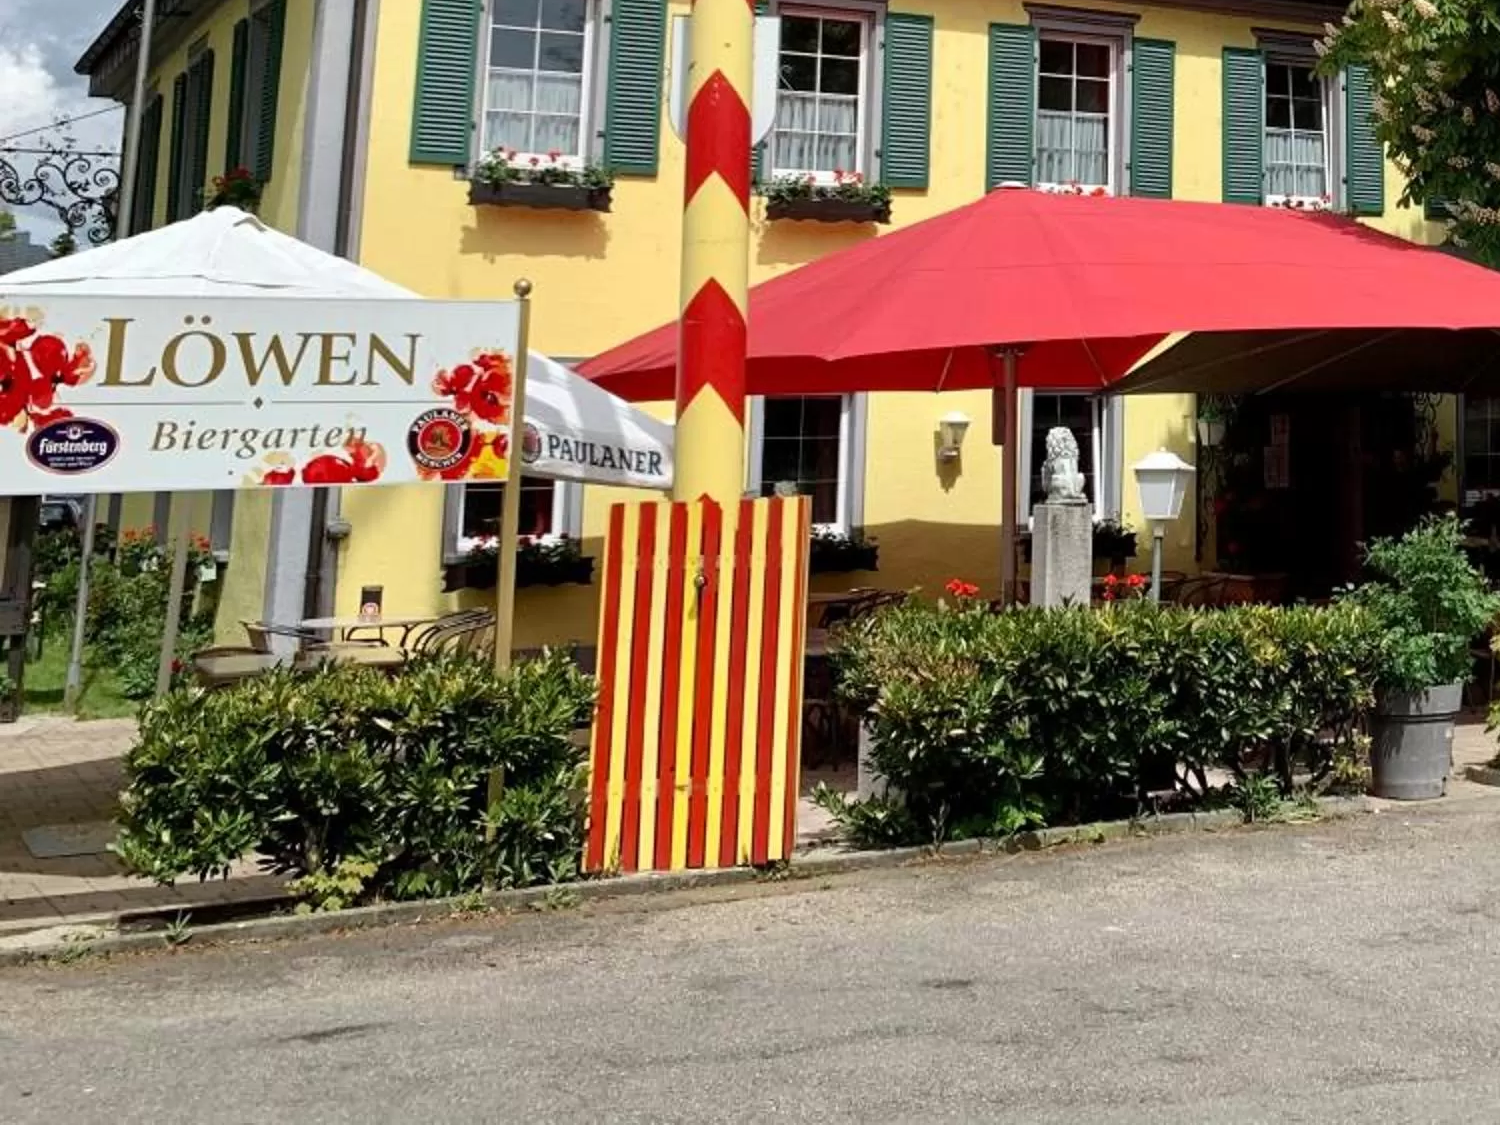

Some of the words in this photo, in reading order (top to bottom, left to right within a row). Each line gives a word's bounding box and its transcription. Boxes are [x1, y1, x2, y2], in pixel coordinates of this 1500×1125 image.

[96, 314, 424, 388] LÖWEN
[149, 420, 367, 460] Biergarten
[547, 434, 663, 476] PAULANER
